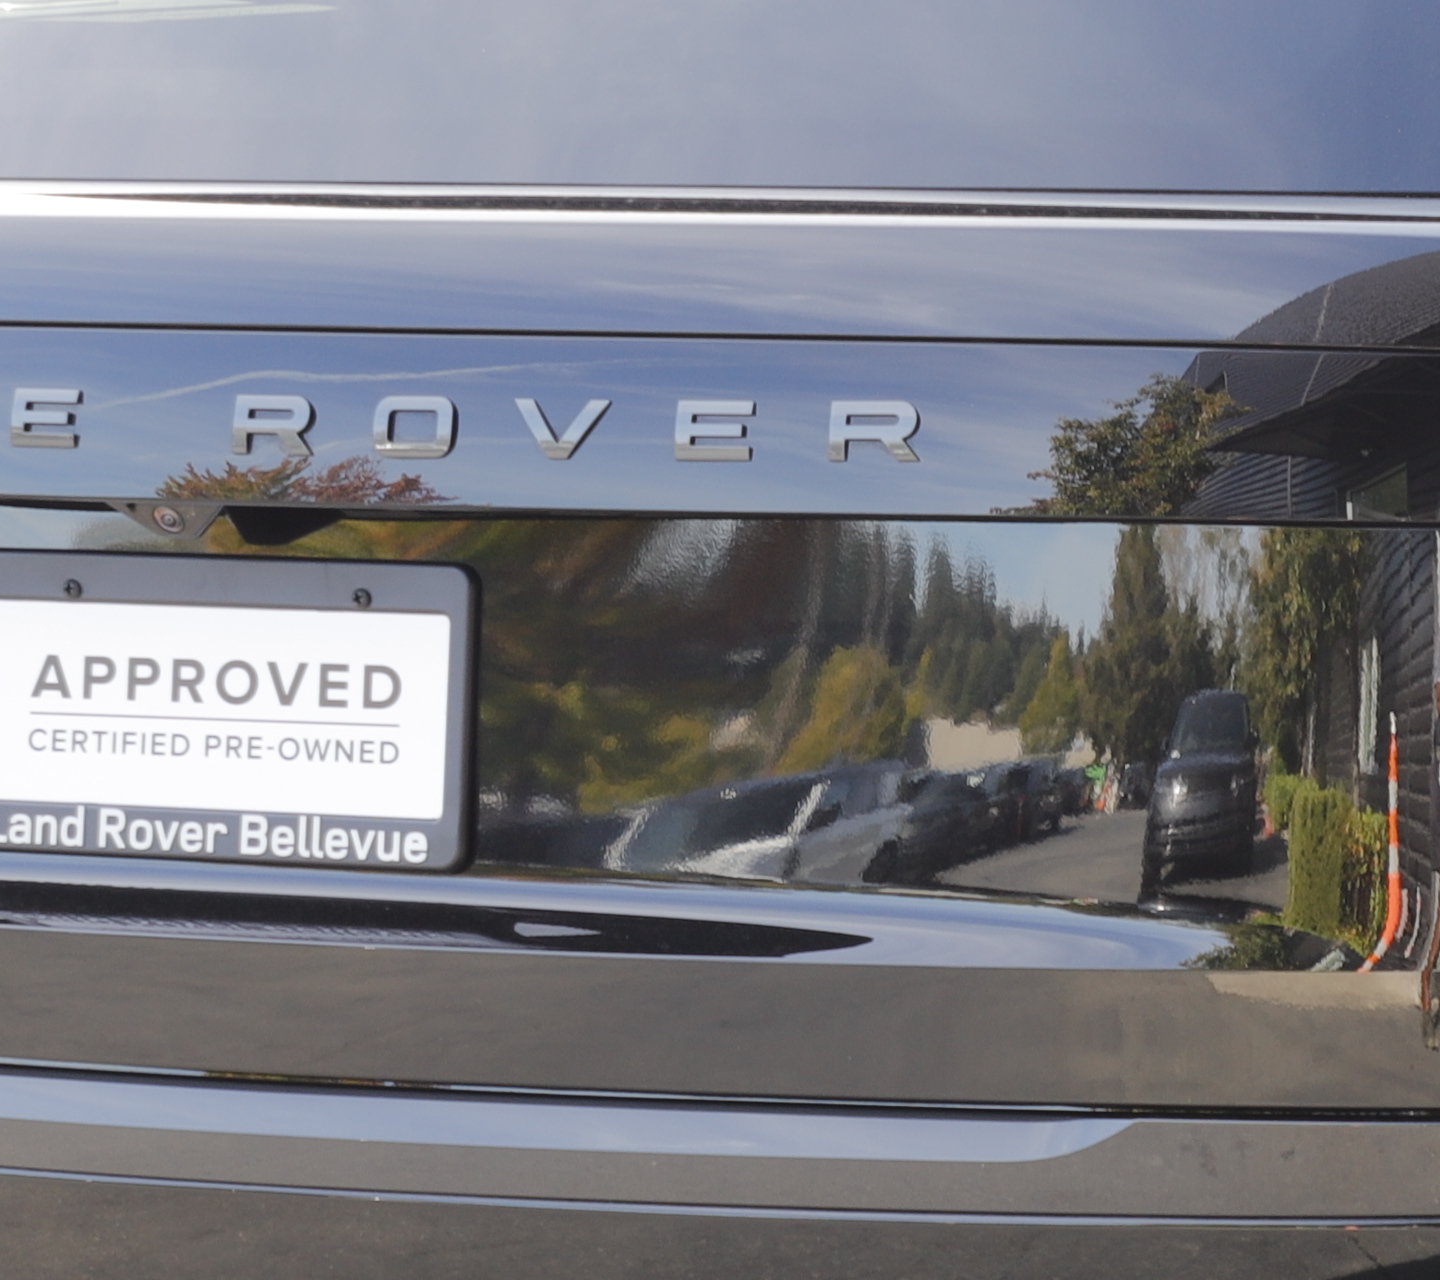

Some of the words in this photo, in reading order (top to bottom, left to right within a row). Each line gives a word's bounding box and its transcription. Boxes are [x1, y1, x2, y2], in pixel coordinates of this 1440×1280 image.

[231, 394, 921, 463] ROVER
[30, 654, 402, 710] APPROVED
[27, 728, 190, 757] CERTIFIED
[204, 735, 400, 765] PRE-OWNED
[97, 807, 228, 854] Rover
[239, 814, 429, 863] Bellevue
